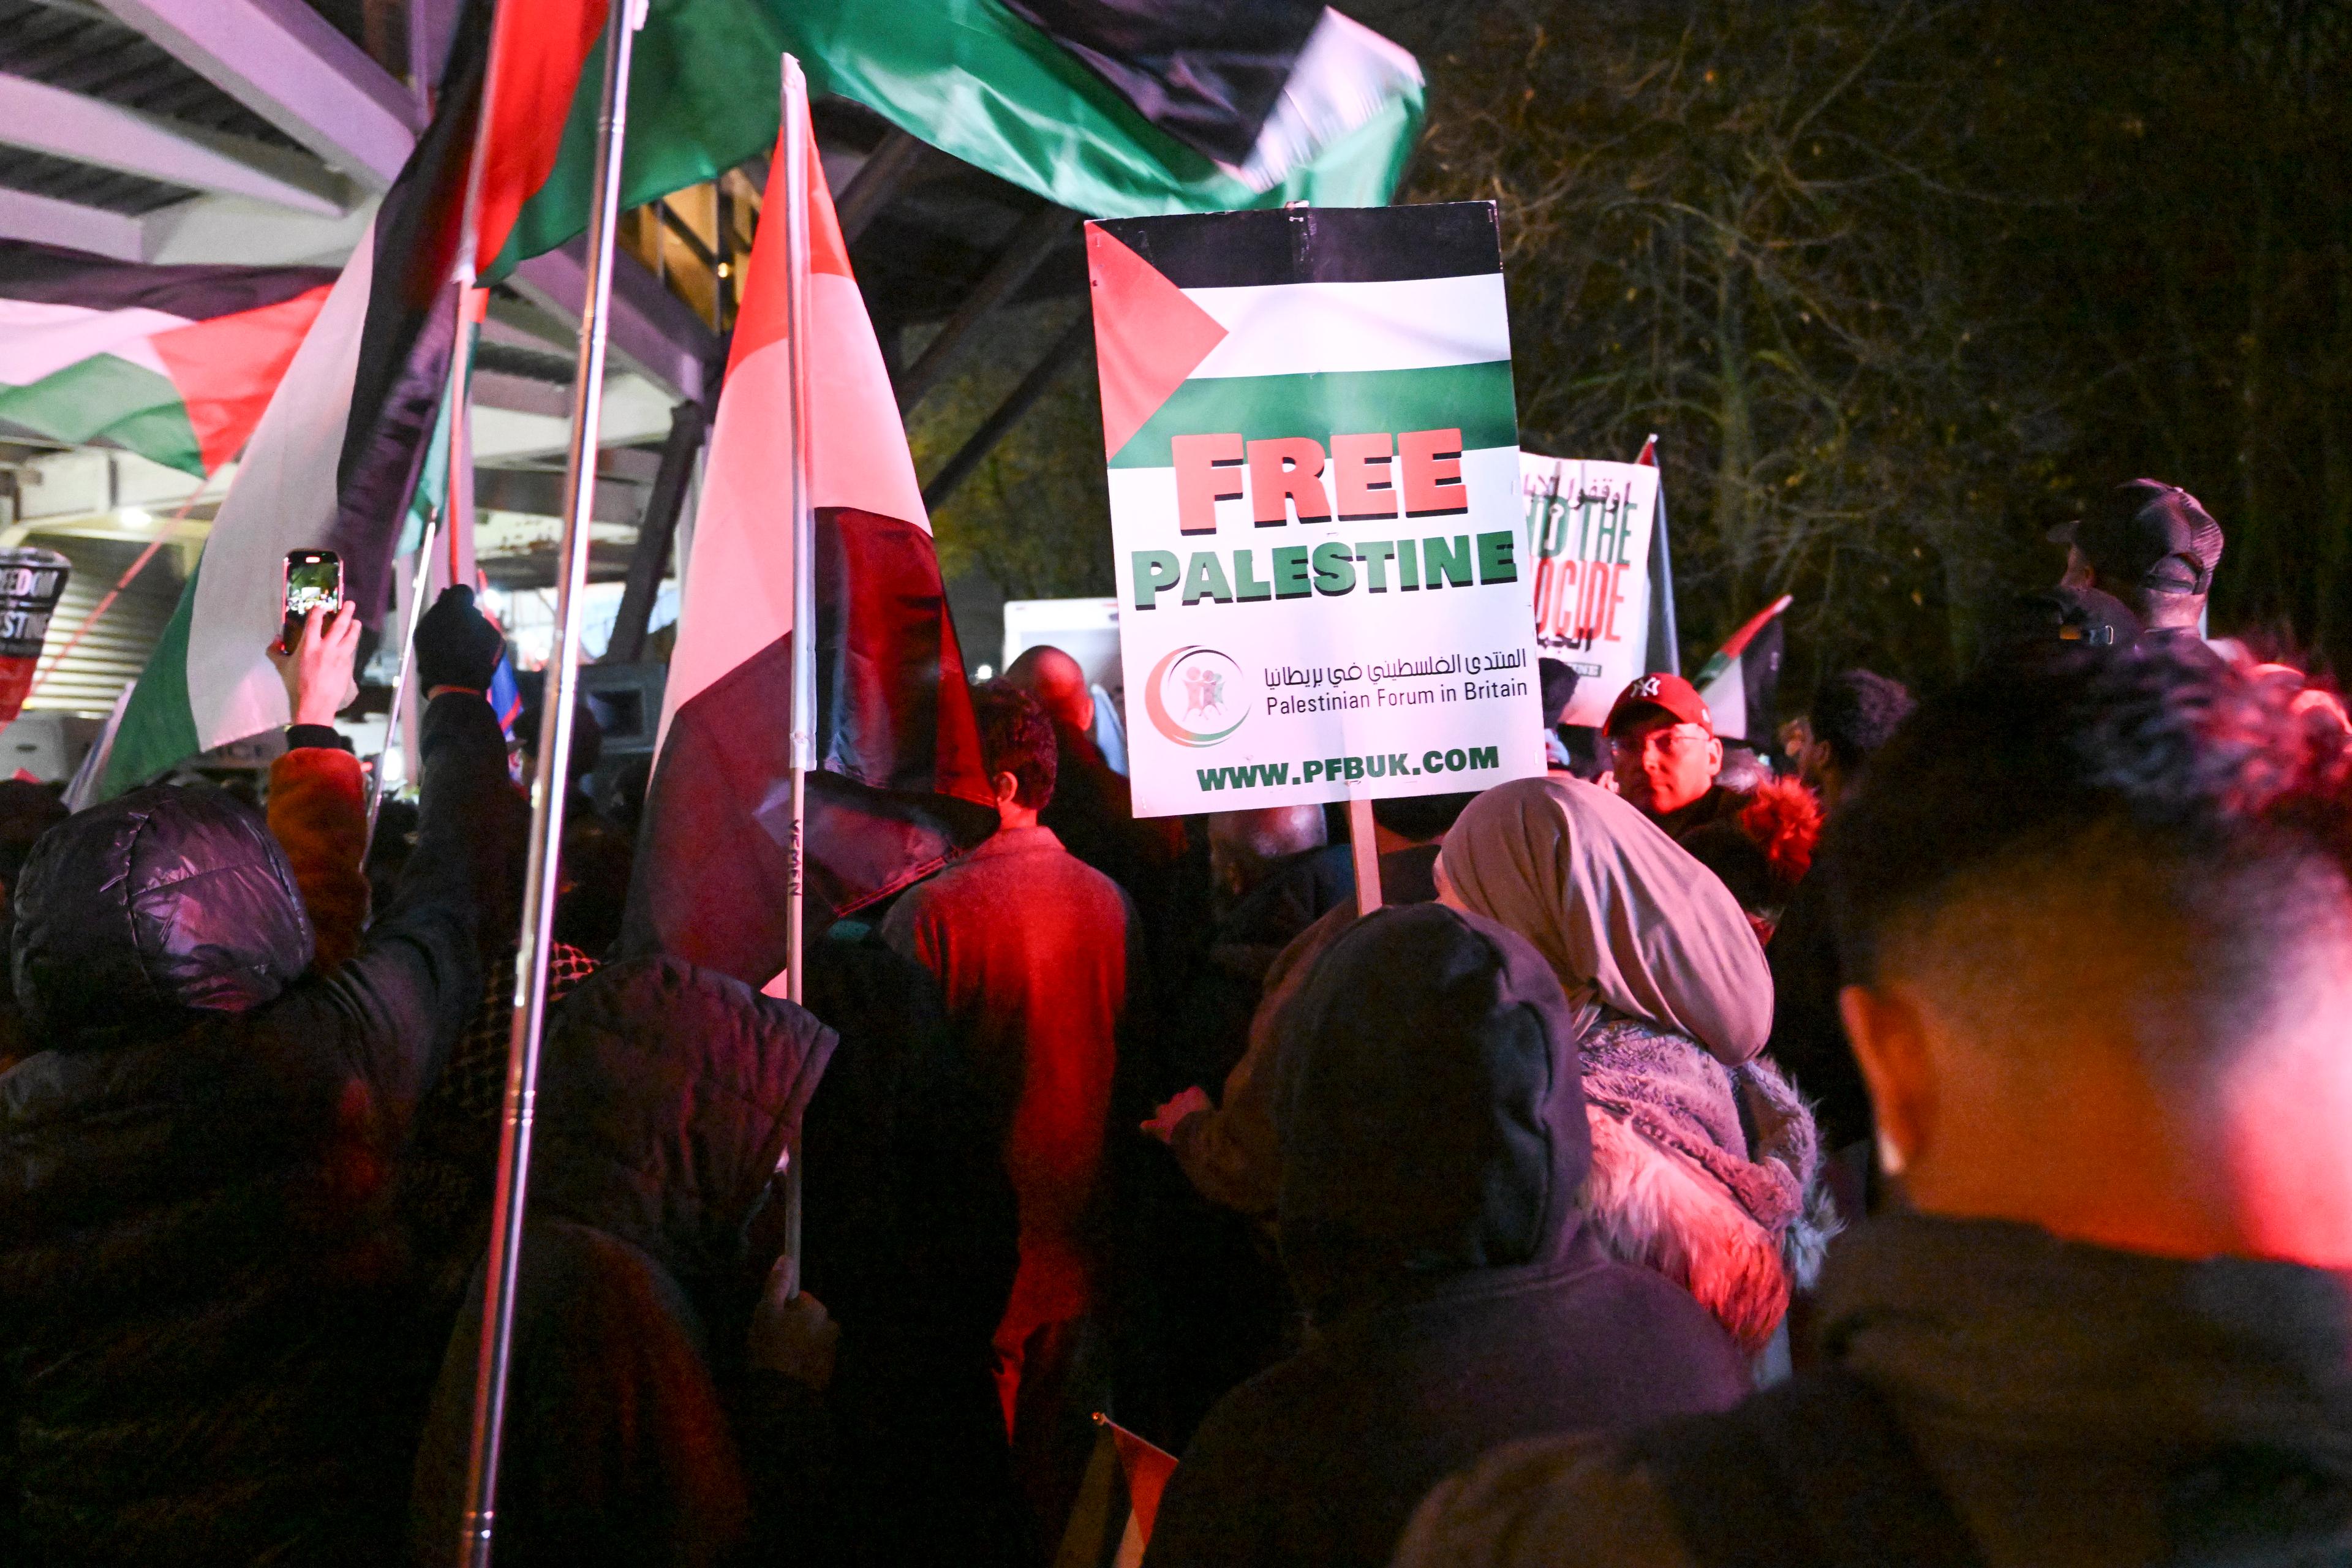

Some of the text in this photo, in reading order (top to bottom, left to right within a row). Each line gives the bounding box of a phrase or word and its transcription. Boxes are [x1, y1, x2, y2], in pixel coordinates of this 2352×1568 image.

[1172, 428, 1468, 536] FREE
[1578, 497, 1638, 565] THE
[1131, 530, 1519, 611] PALESTINE
[1529, 556, 1630, 643] OCIDE
[1264, 648, 1526, 690] المنتدى الفلسطيني في بريطانيا
[1267, 678, 1528, 715] Palestinian Forum in Britain
[1197, 745, 1500, 792] WWW.PFBUK.COM
